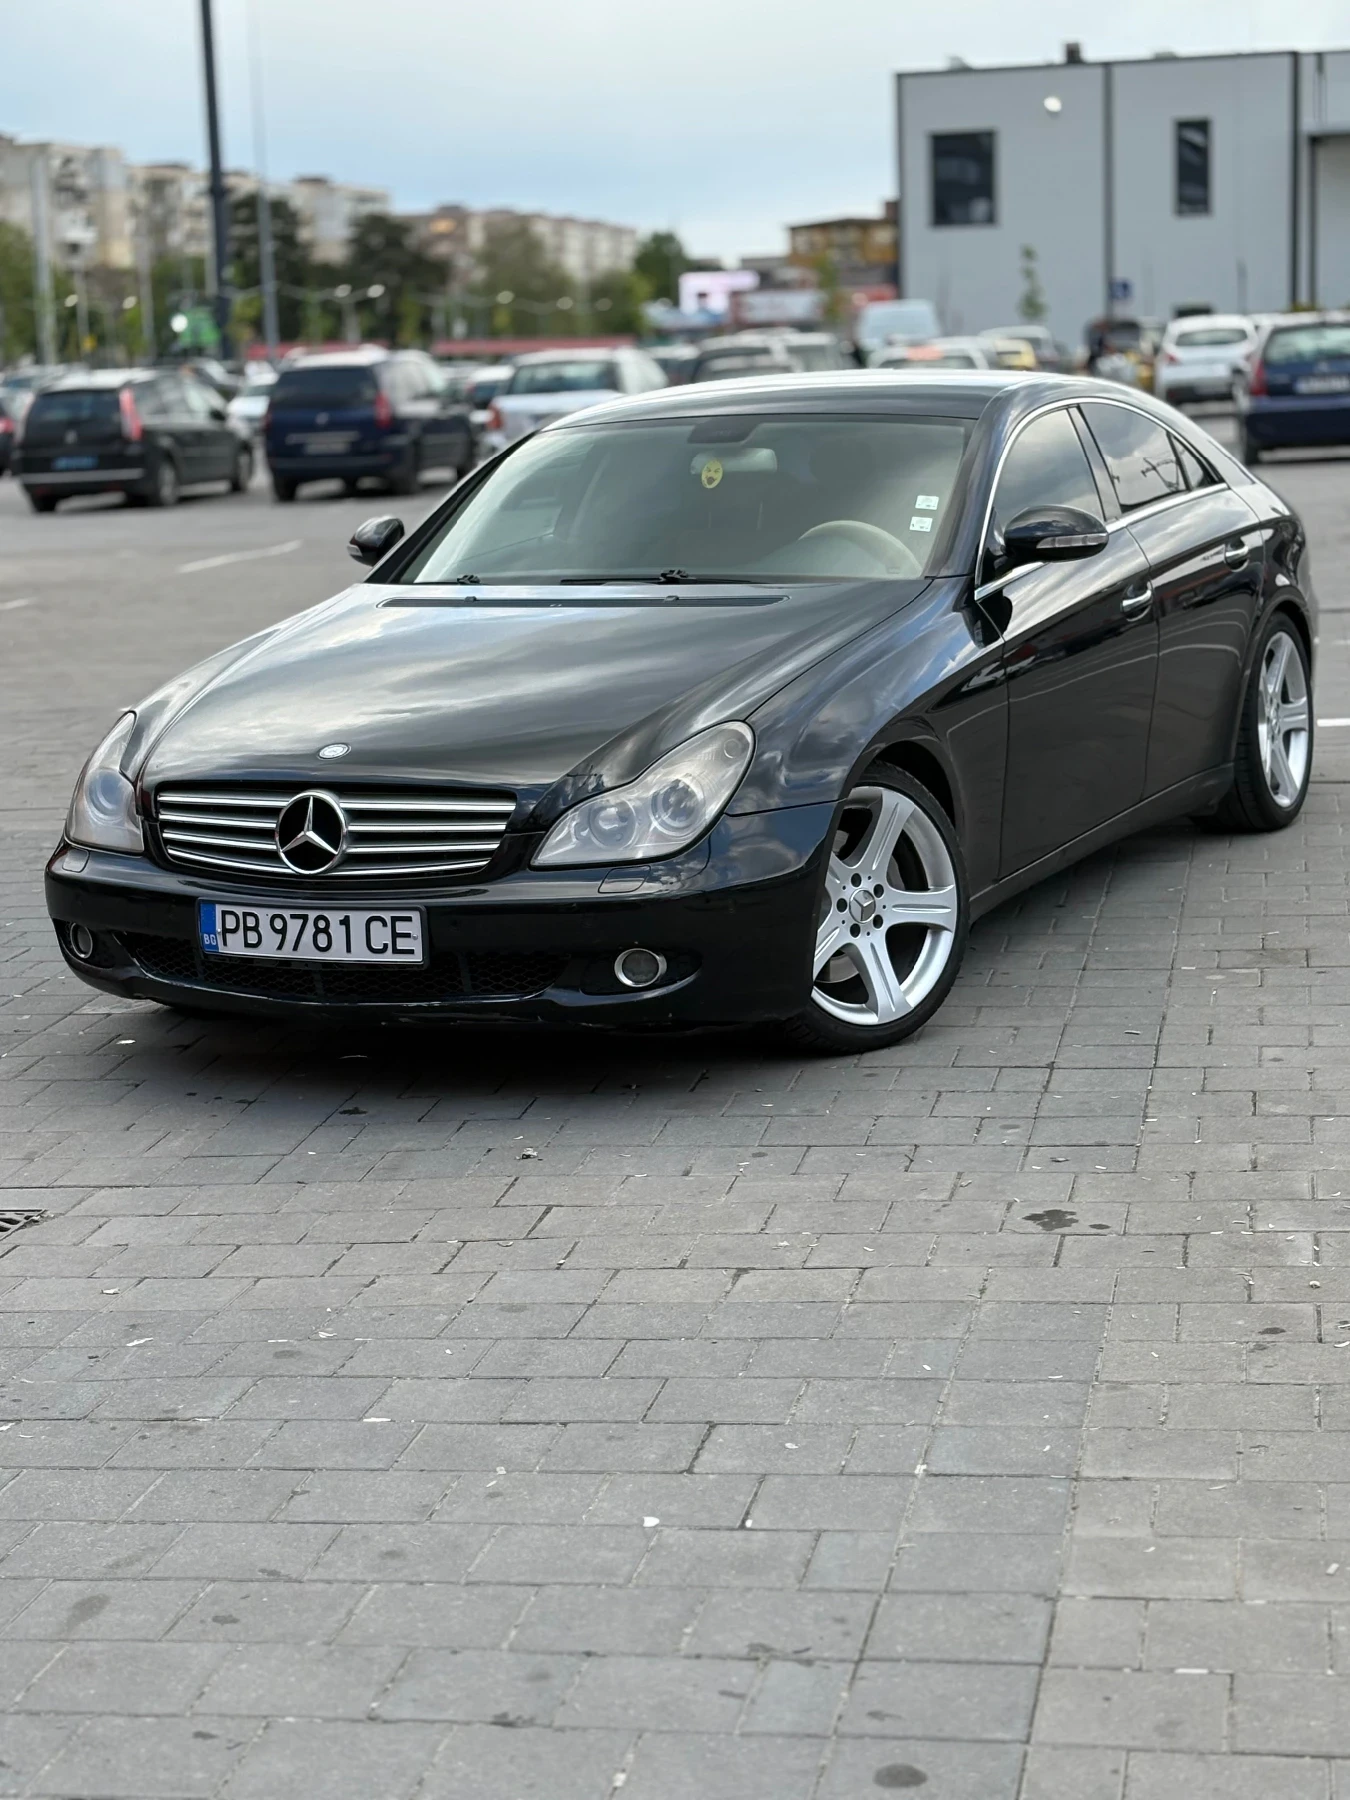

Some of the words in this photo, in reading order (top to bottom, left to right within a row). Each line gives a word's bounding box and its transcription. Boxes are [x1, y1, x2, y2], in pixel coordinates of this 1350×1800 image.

[203, 933, 217, 946] BG
[220, 909, 263, 949] PB
[269, 913, 353, 954] 9781
[364, 914, 415, 955] CE
